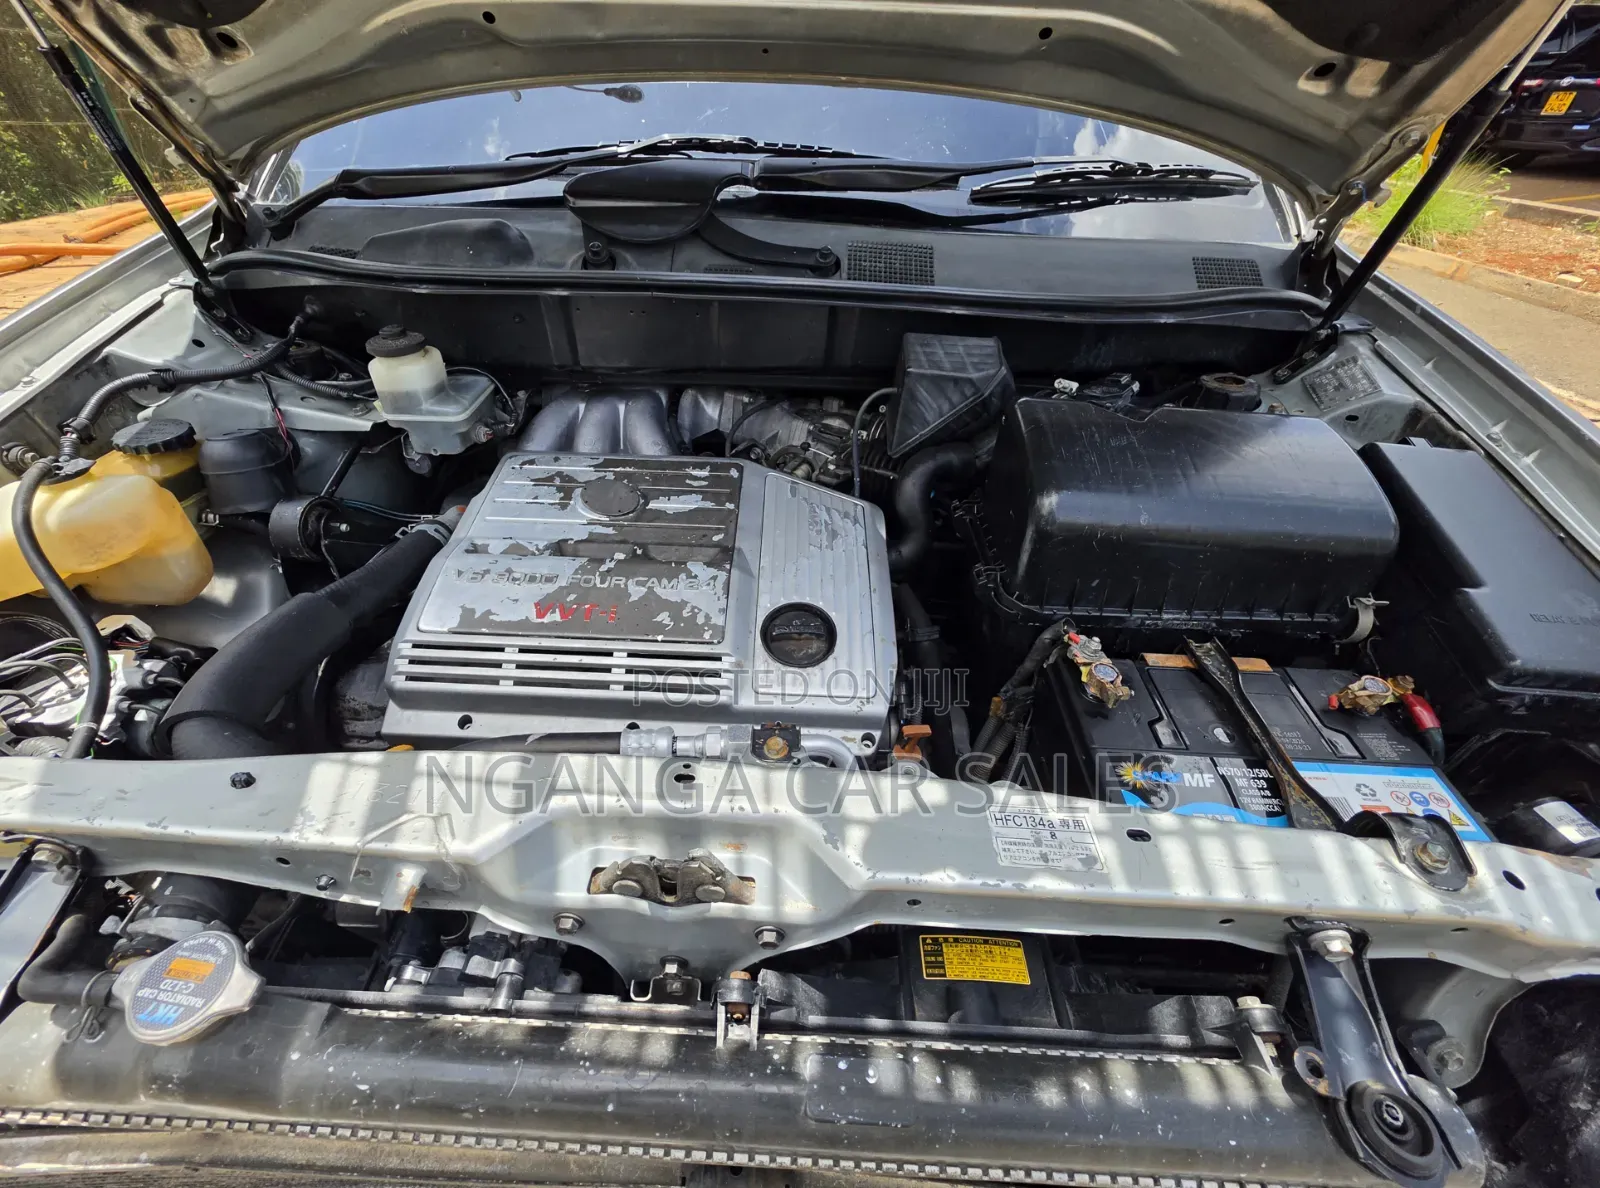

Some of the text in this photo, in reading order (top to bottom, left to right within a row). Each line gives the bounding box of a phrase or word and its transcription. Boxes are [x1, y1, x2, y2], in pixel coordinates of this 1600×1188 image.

[453, 568, 717, 592] V6 3000 FOUR CAM 24
[1182, 772, 1216, 788] MF
[1235, 777, 1267, 789] MF 639
[993, 813, 1086, 831] HFC134a 専用
[1049, 831, 1058, 840] 8
[988, 939, 1019, 947] ATTENTION
[136, 987, 206, 1009] RADIATOR CAP
[136, 1001, 186, 1027] HKT
